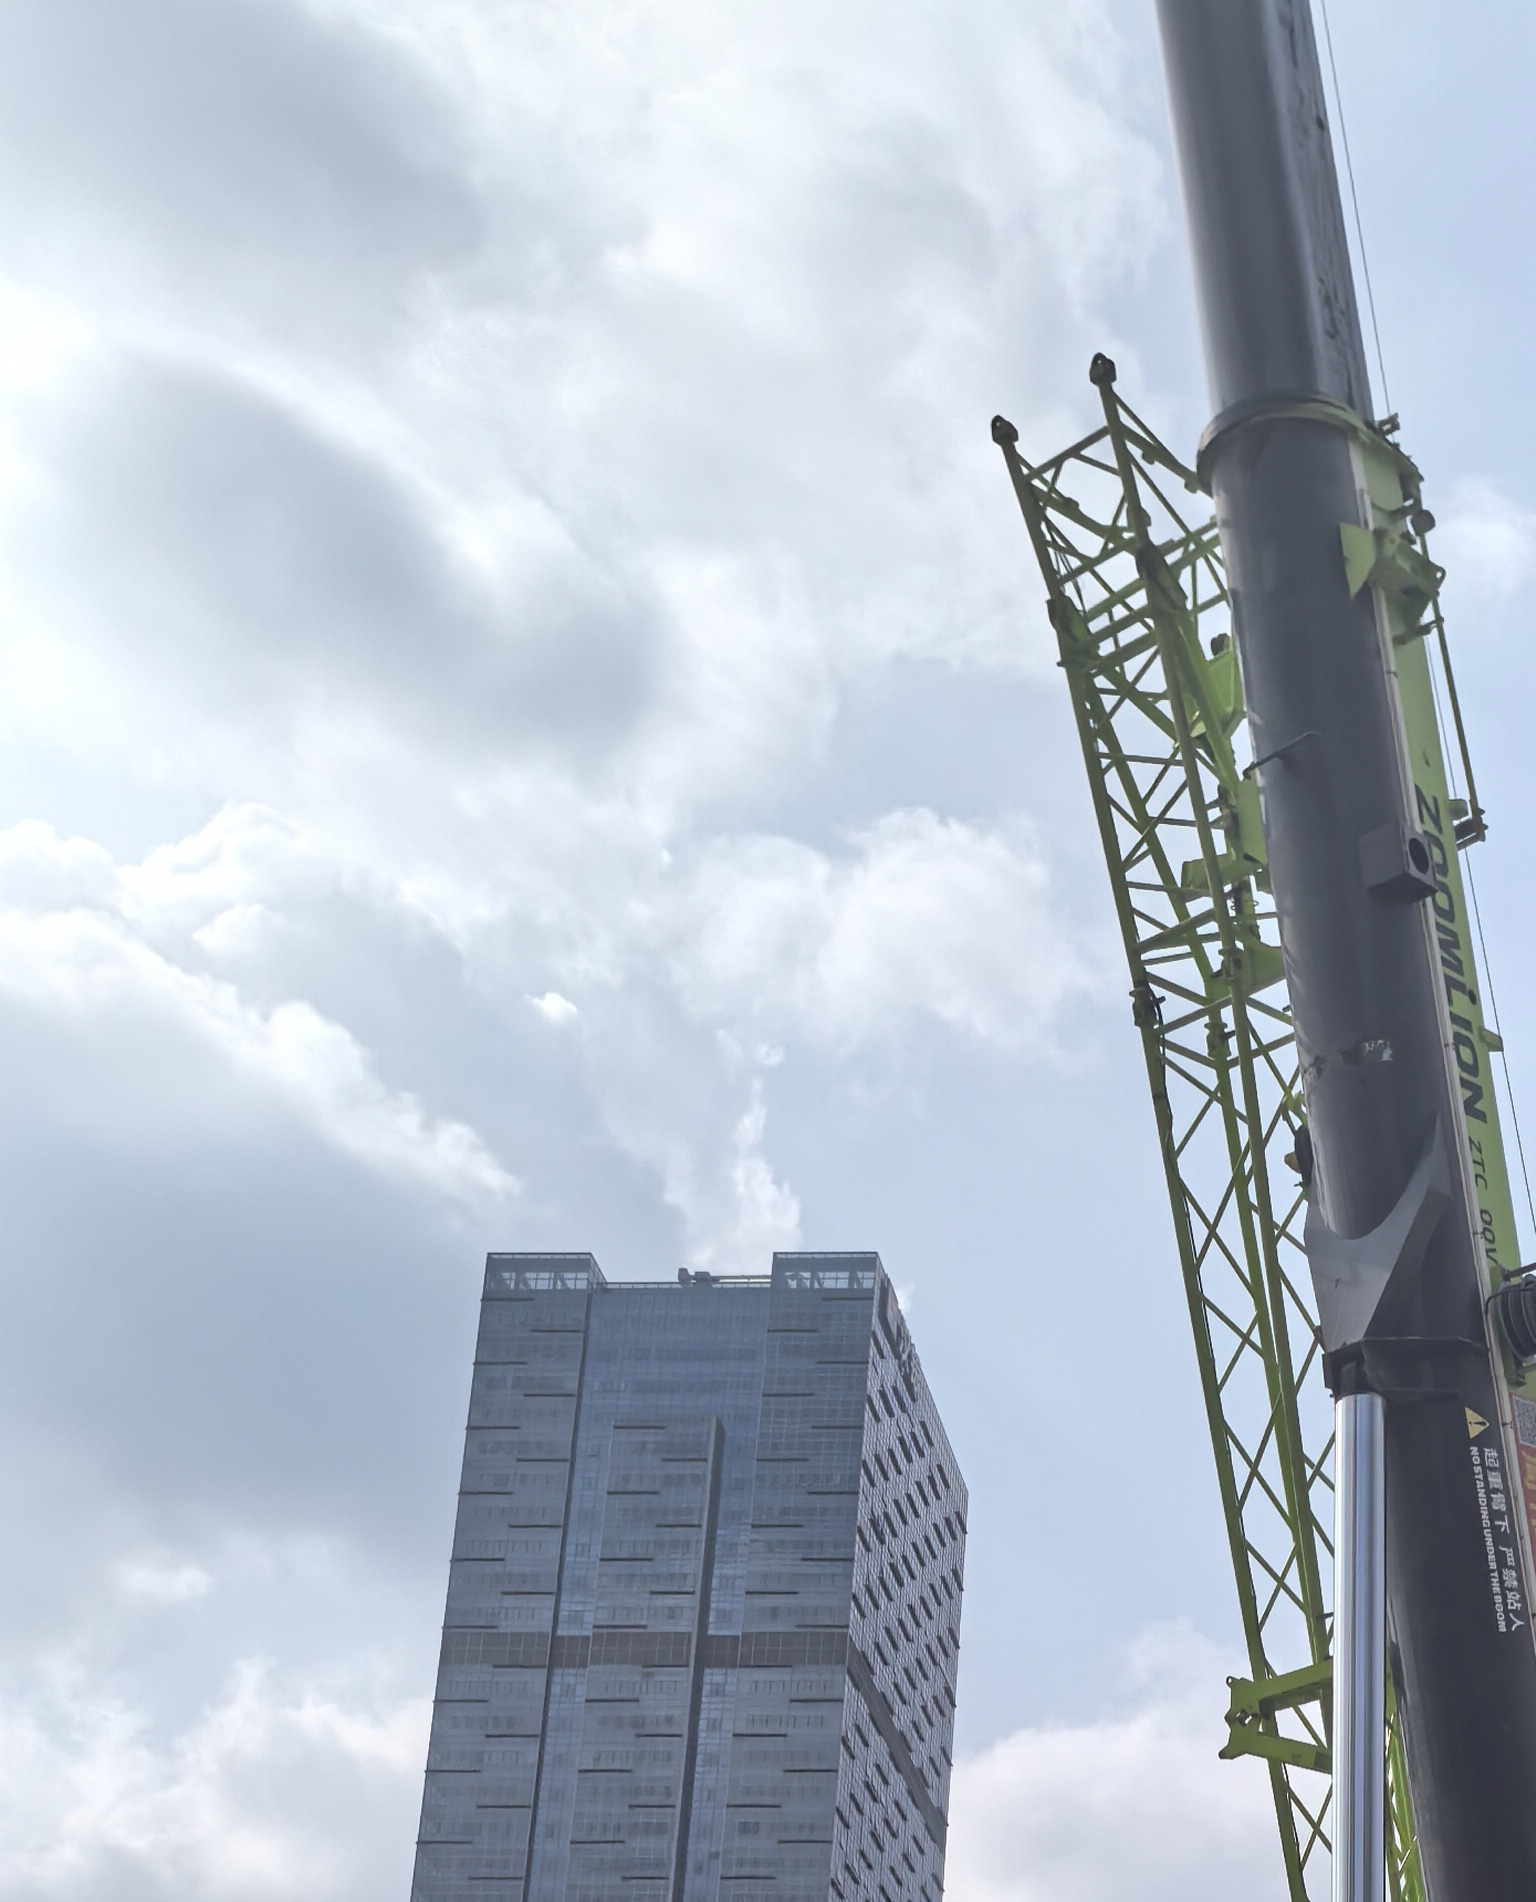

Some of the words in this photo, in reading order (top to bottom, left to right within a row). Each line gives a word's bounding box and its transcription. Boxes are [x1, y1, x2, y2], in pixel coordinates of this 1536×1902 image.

[1413, 783, 1488, 1125] ZOOMLION
[1470, 1446, 1480, 1464] NO
[1473, 1465, 1491, 1528] STANDING
[1483, 1528, 1497, 1570] UNDER
[1490, 1570, 1502, 1594] THE
[1494, 1594, 1507, 1633] BOOM
